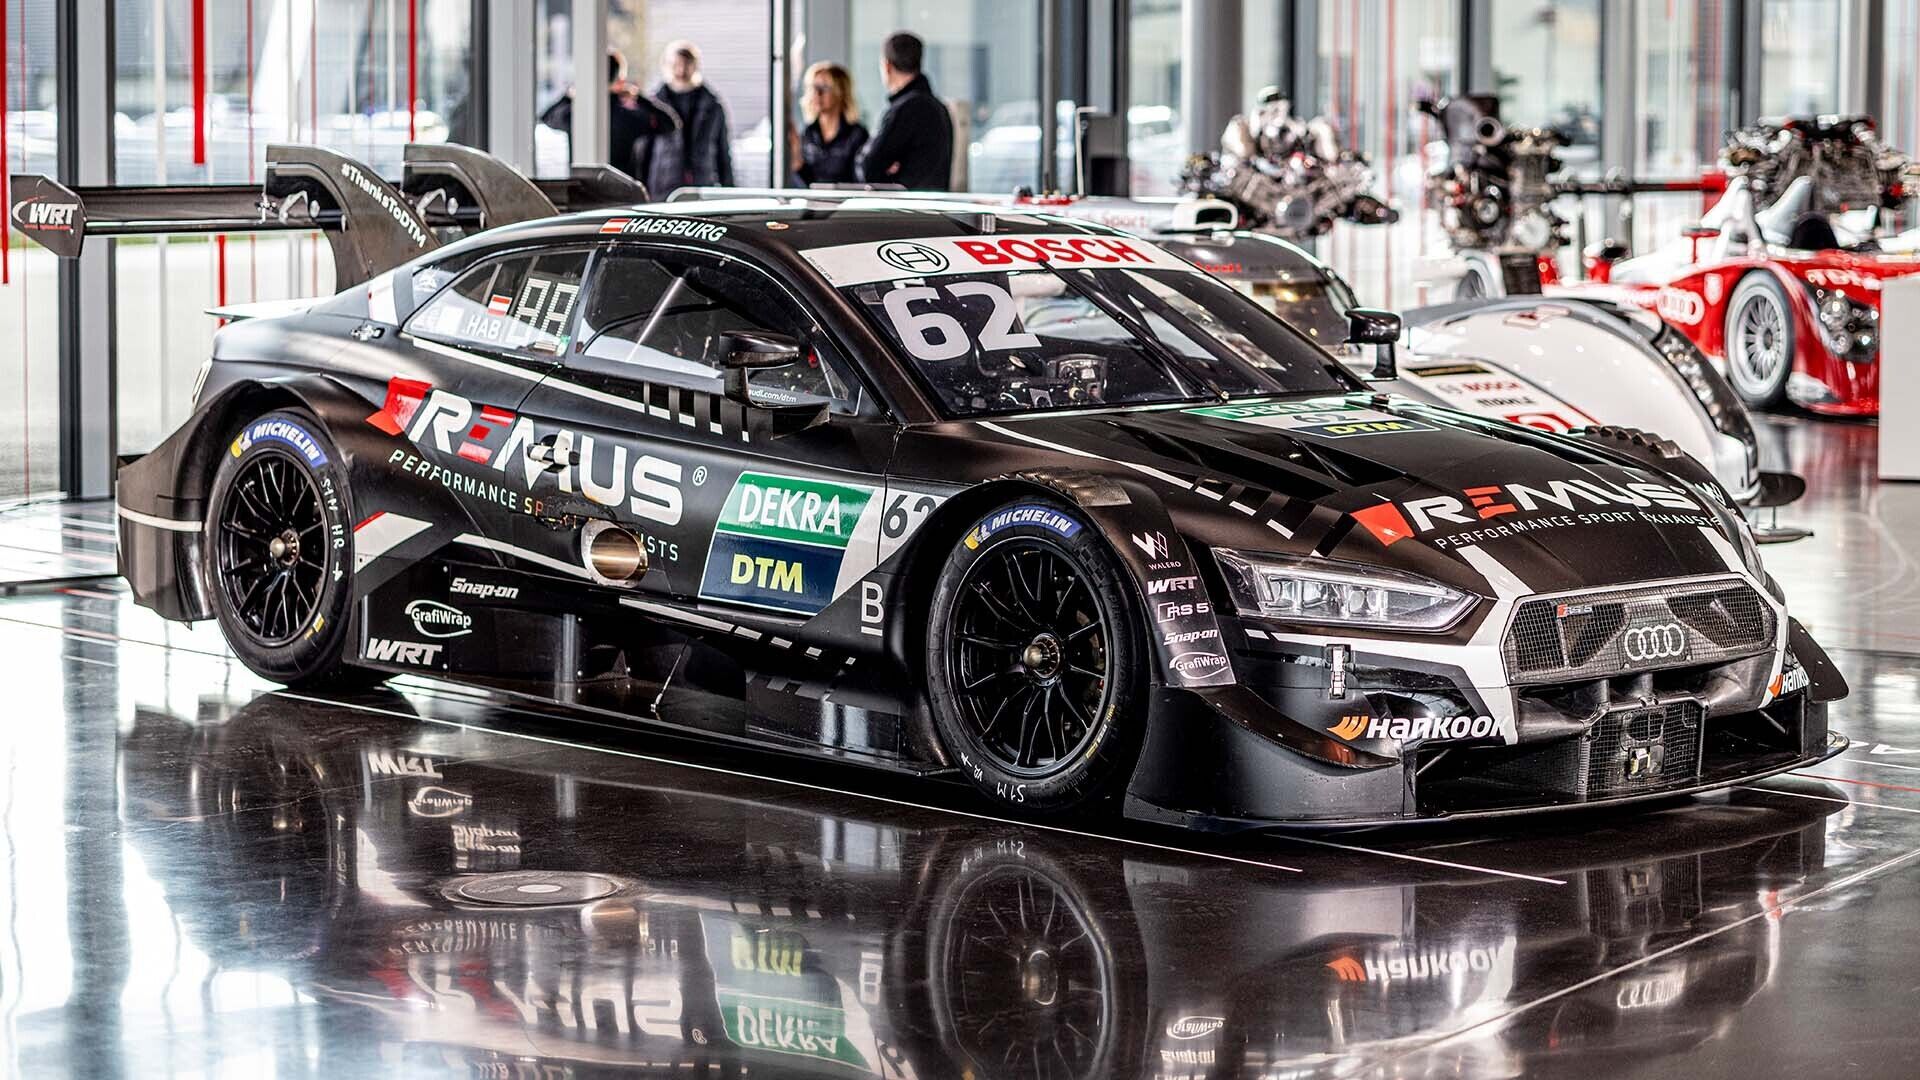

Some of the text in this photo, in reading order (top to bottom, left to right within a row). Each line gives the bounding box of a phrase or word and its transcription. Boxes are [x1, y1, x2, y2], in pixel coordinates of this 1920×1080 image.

[29, 203, 78, 224] WRT
[341, 163, 427, 249] #ThanksToDTM
[623, 218, 728, 241] HABSBURG
[951, 239, 1156, 265] BOSCH
[882, 281, 1043, 361] 62
[1323, 421, 1414, 435] DTM
[252, 422, 320, 461] MICHELIN
[388, 449, 517, 510] PERFORMANCE
[738, 484, 841, 536] DEKRA
[992, 509, 1073, 533] MICHELIN
[1434, 515, 1576, 549] PERFORMANCE
[1581, 510, 1631, 525] SPORT
[731, 553, 803, 593] DTM
[1149, 560, 1182, 571] WALERO
[450, 577, 519, 599] Snap-on
[1148, 576, 1198, 595] WRT
[411, 607, 472, 629] GrafiWrap
[1163, 629, 1218, 645] Snap-on
[366, 637, 443, 665] WRT
[1175, 655, 1227, 672] GrafiWrap
